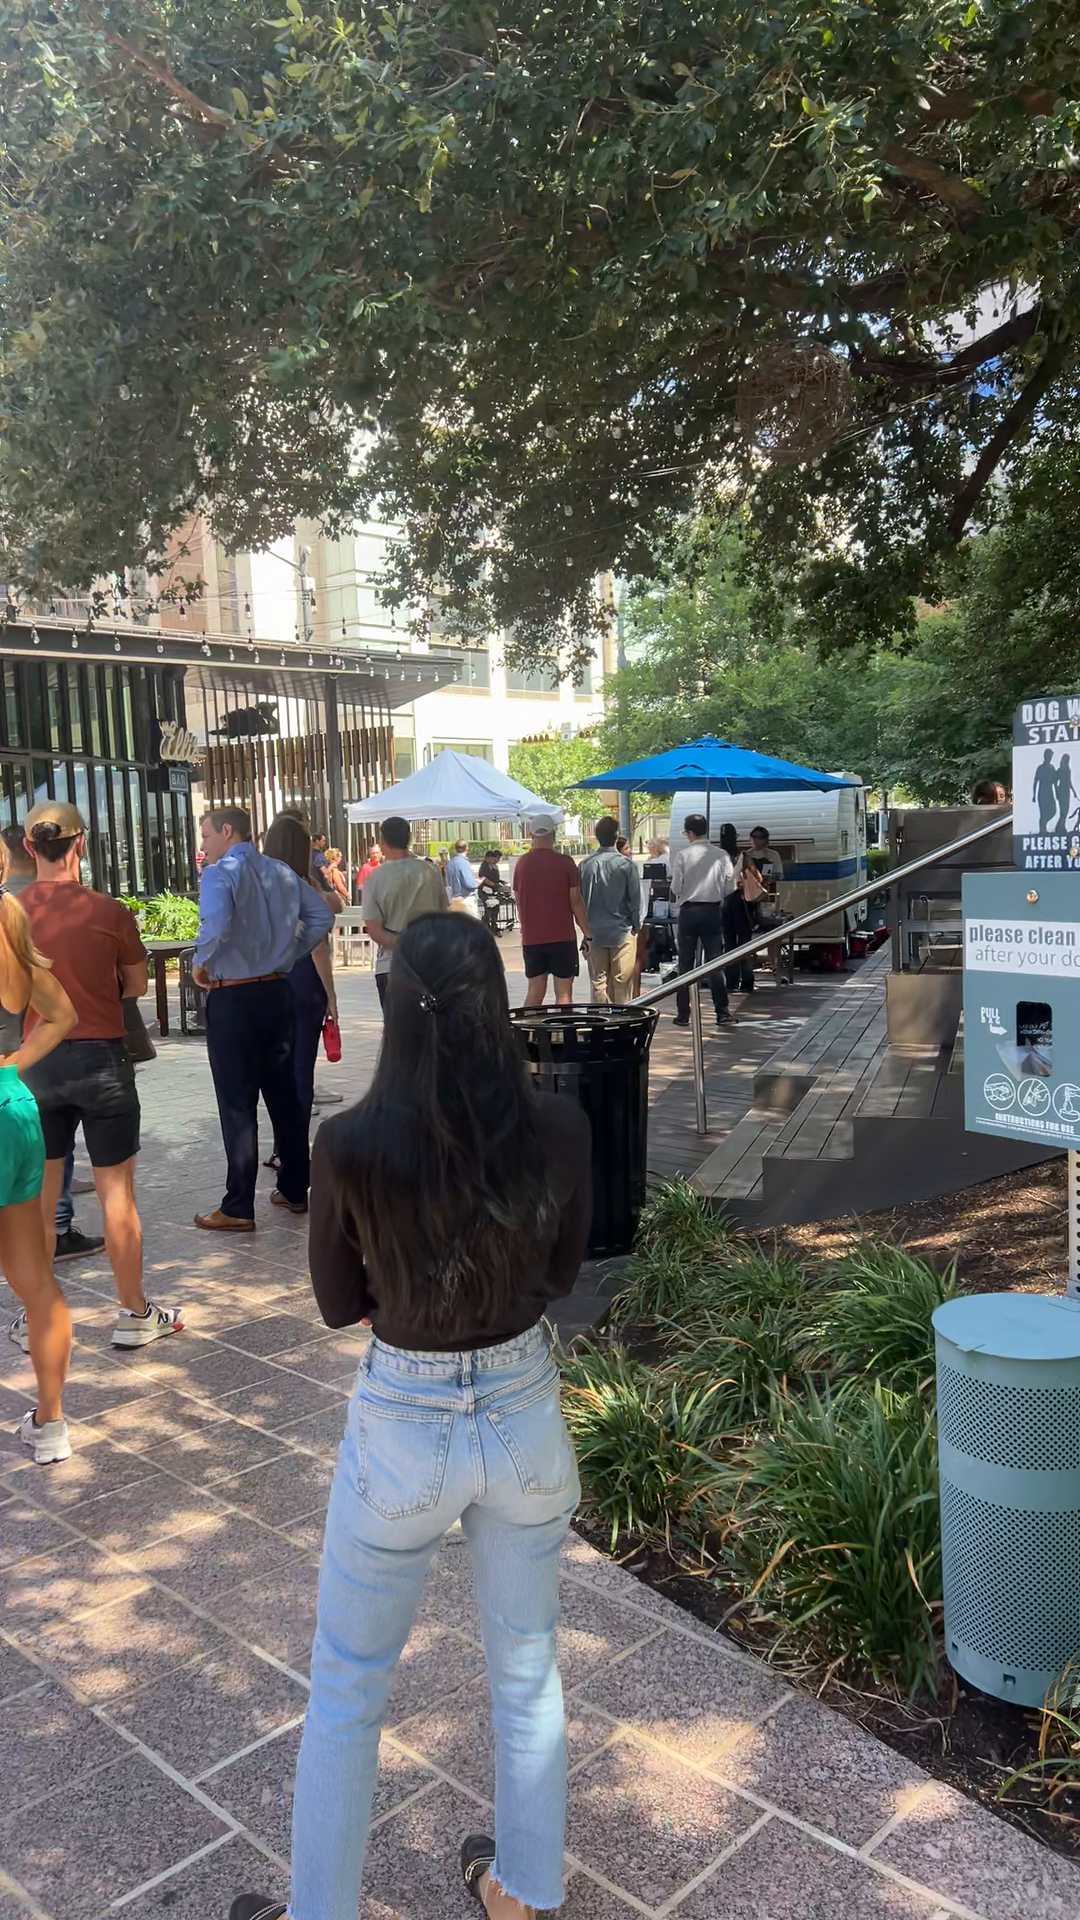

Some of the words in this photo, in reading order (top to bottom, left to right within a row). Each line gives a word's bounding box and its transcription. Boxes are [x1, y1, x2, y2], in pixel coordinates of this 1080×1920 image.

[1022, 701, 1059, 724] DOG
[171, 774, 186, 786] BAR
[1023, 836, 1068, 850] PLEASE
[1025, 855, 1062, 868] AFTER
[969, 924, 1023, 943] please
[1028, 927, 1076, 946] clean
[975, 945, 1013, 963] after
[1017, 951, 1056, 968] your
[981, 1007, 999, 1019] PULL
[995, 1112, 1044, 1129] INSTRUCTIONS
[1045, 1121, 1060, 1132] FOR
[1060, 1123, 1075, 1134] USE
